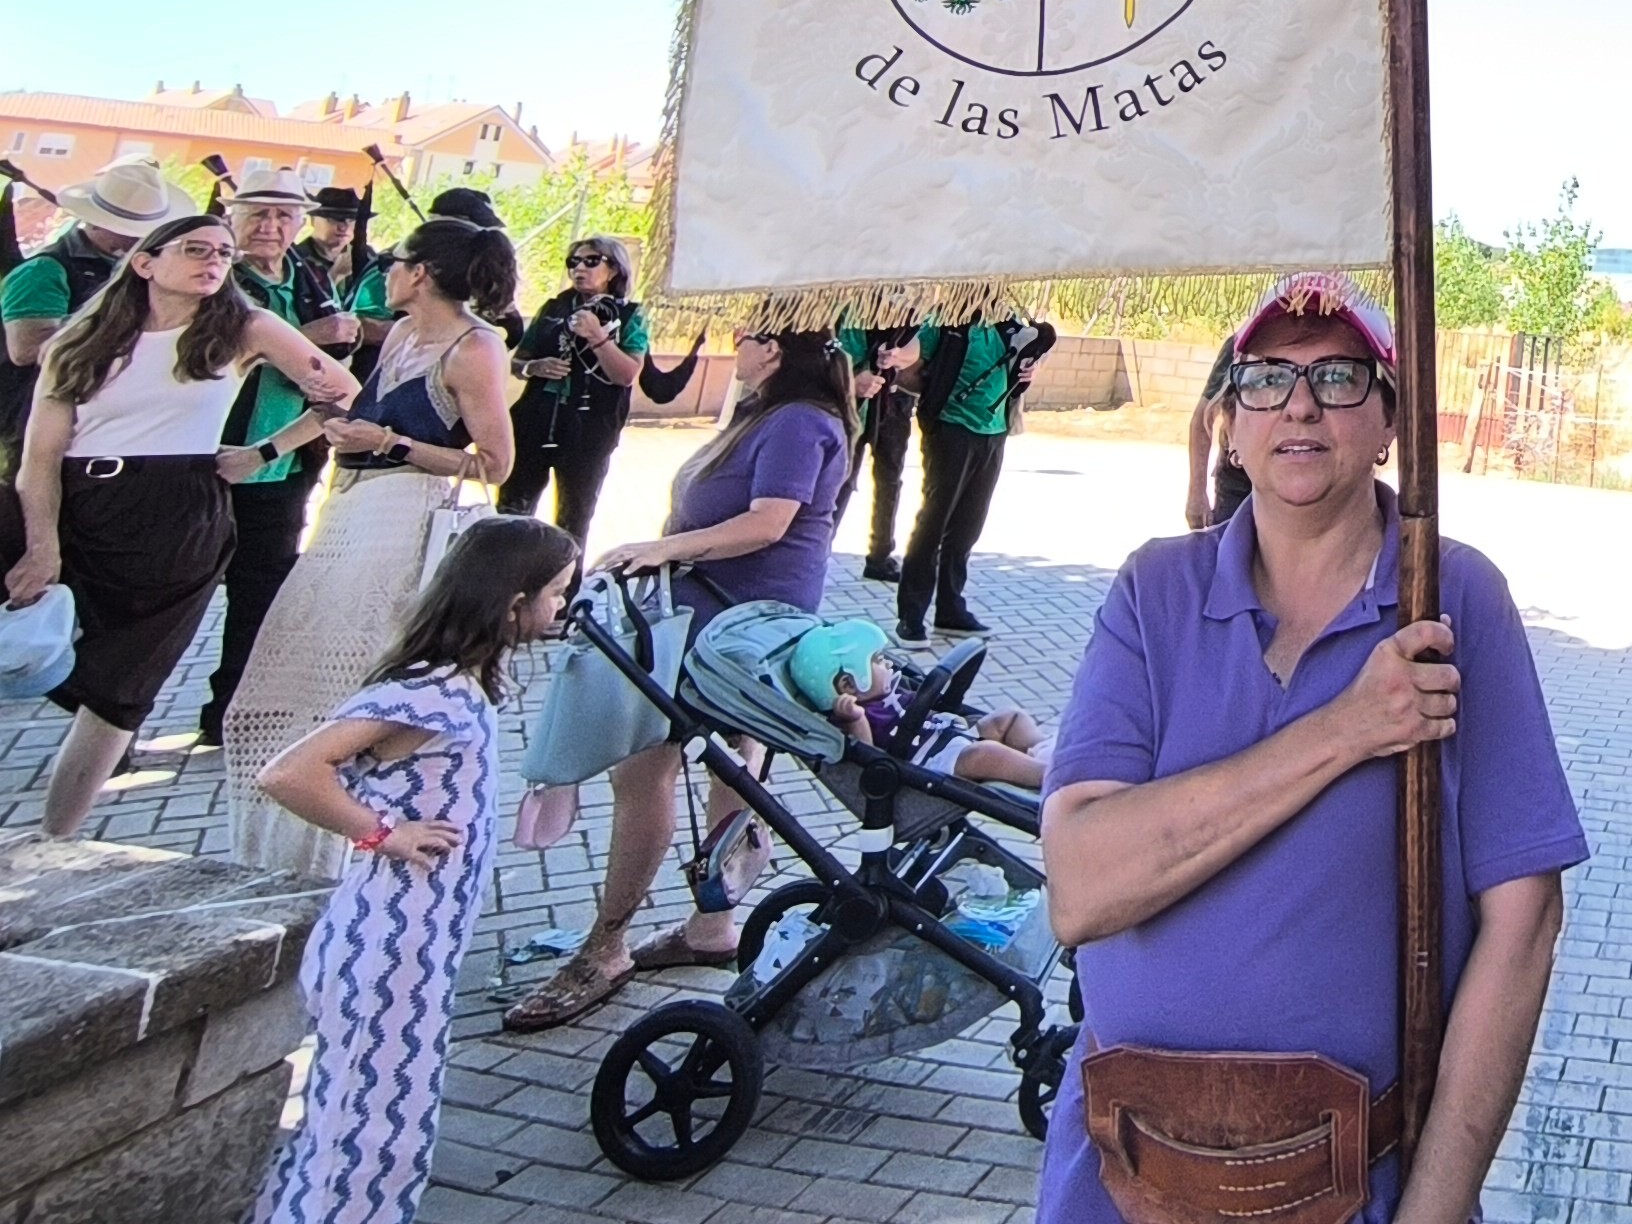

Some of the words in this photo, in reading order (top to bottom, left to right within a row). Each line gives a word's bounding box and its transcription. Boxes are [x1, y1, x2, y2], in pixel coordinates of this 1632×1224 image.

[855, 46, 921, 108] de
[935, 80, 1020, 140] las
[1043, 37, 1228, 140] Matas
